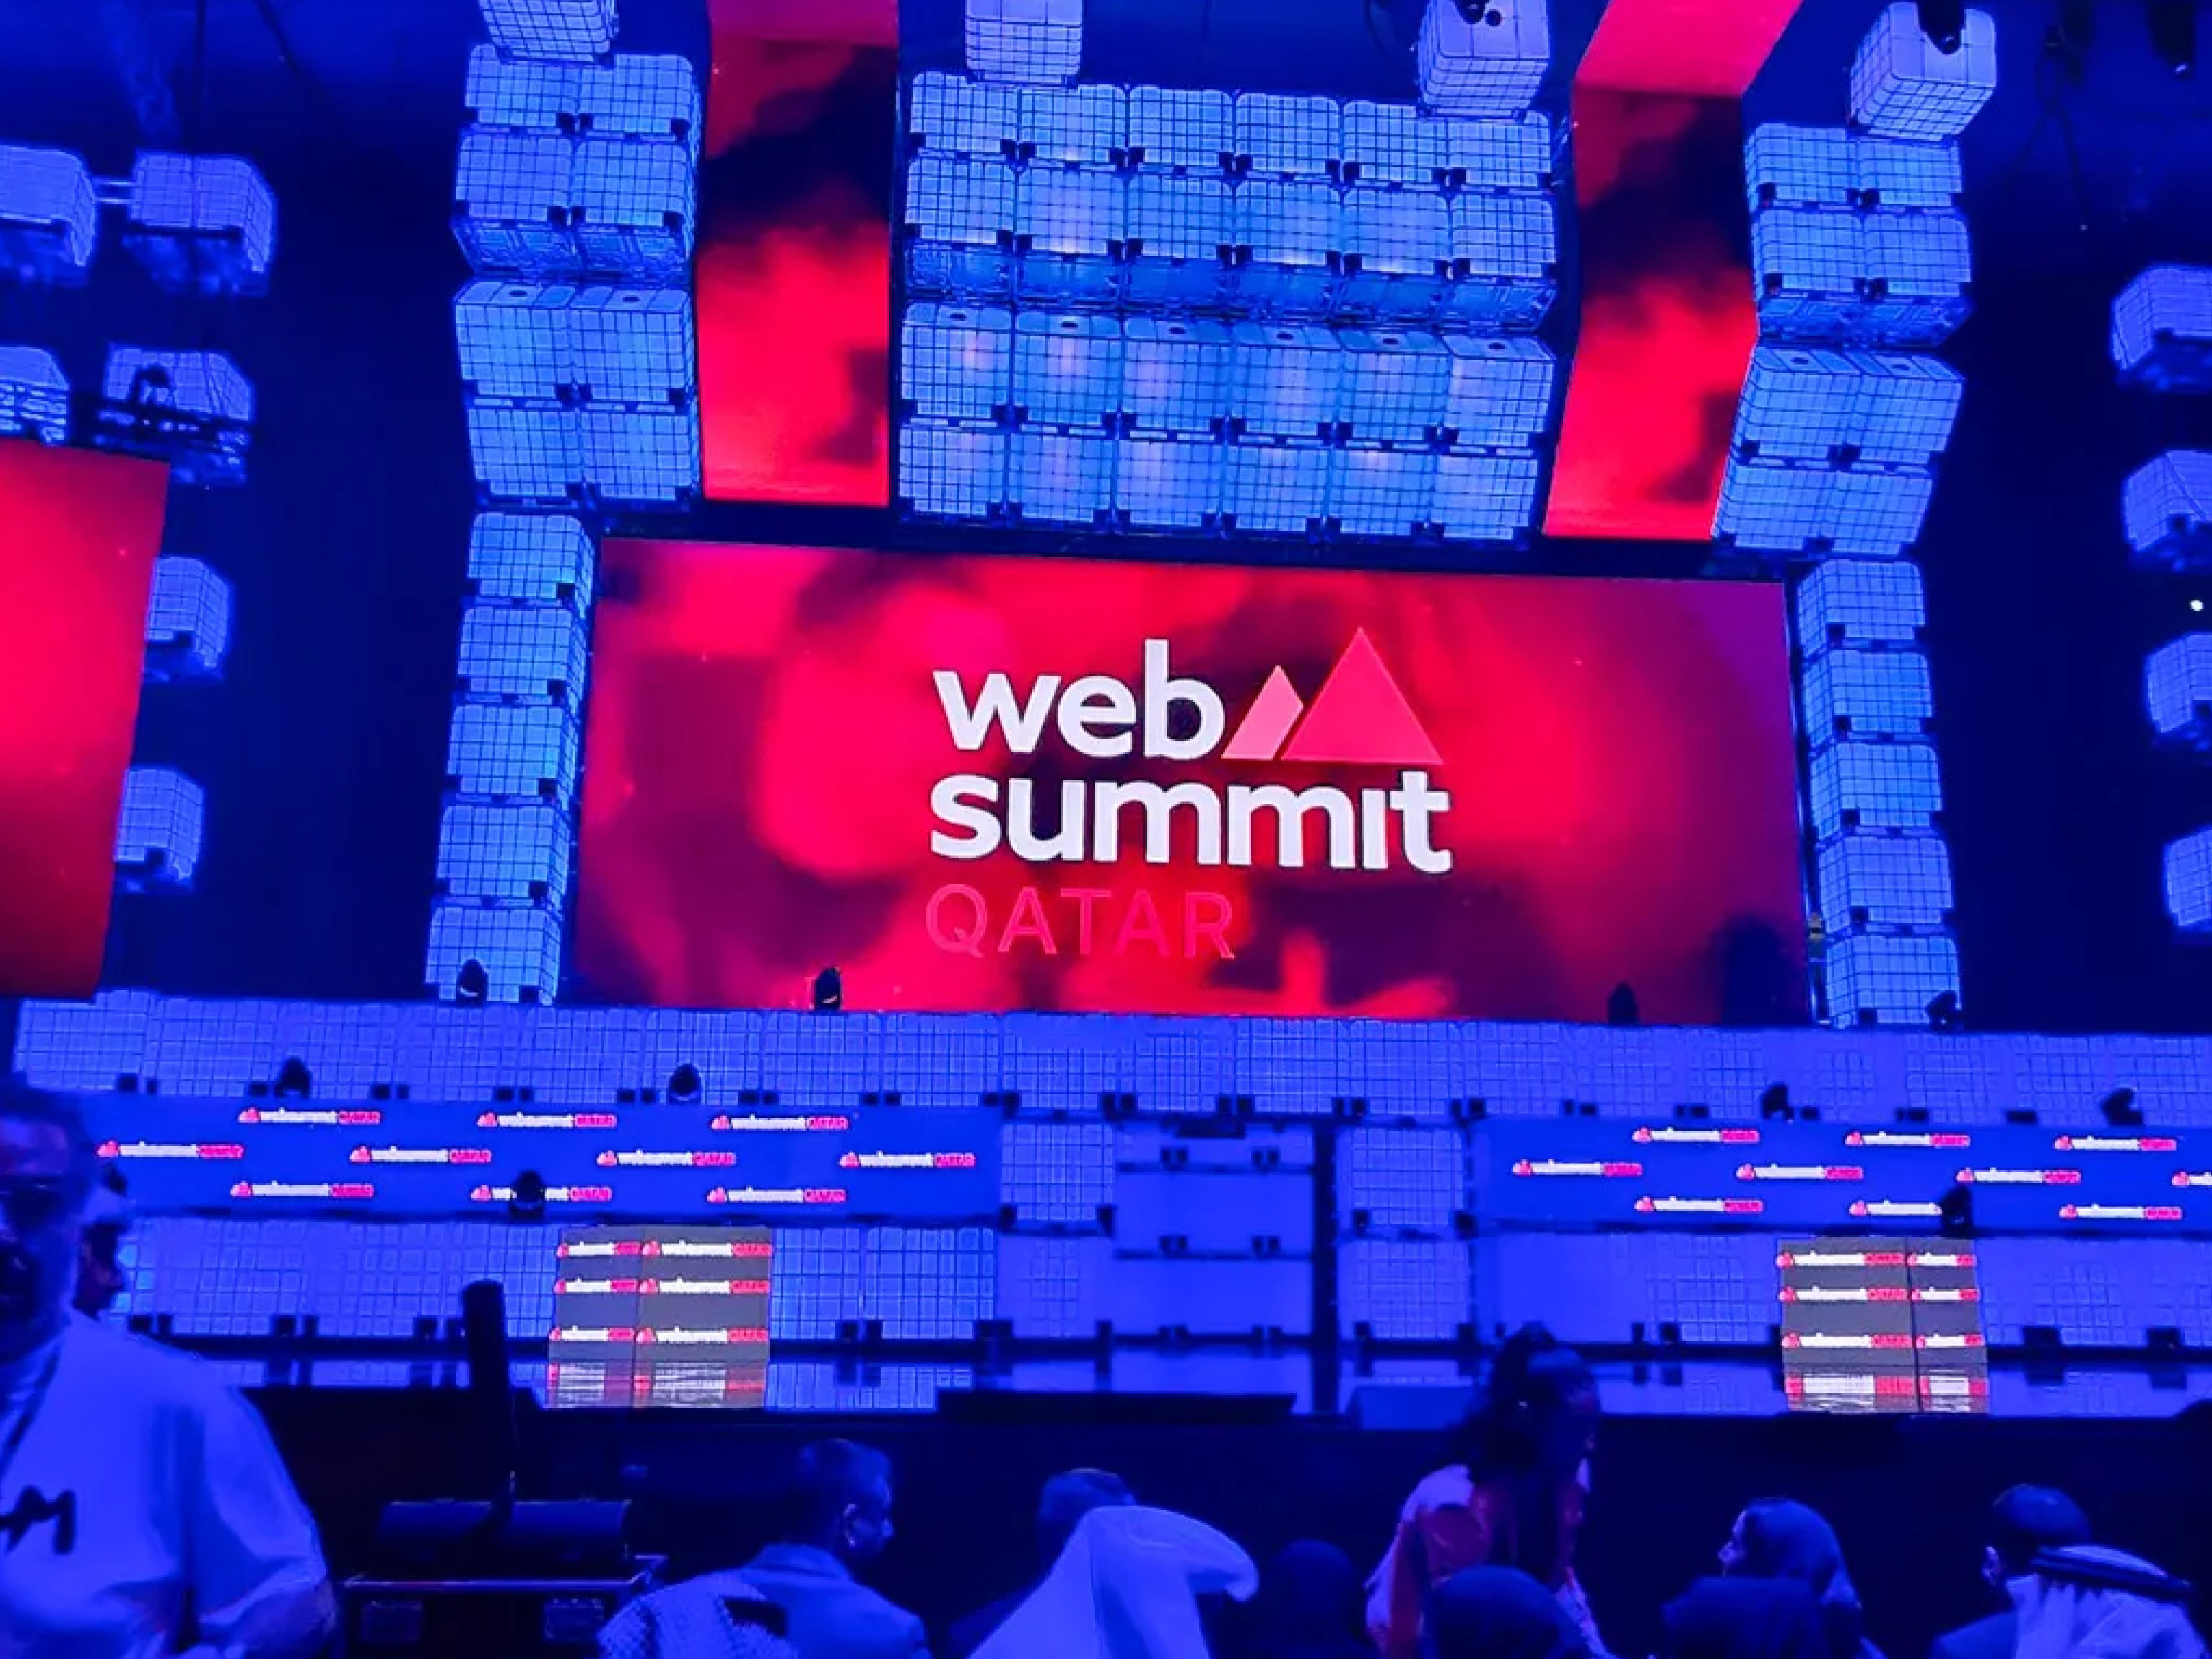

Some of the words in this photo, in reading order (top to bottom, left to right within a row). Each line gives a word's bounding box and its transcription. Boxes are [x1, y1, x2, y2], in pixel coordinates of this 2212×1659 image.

[931, 638, 1226, 759] web
[930, 770, 1453, 874] summit
[926, 883, 1235, 959] QATAR
